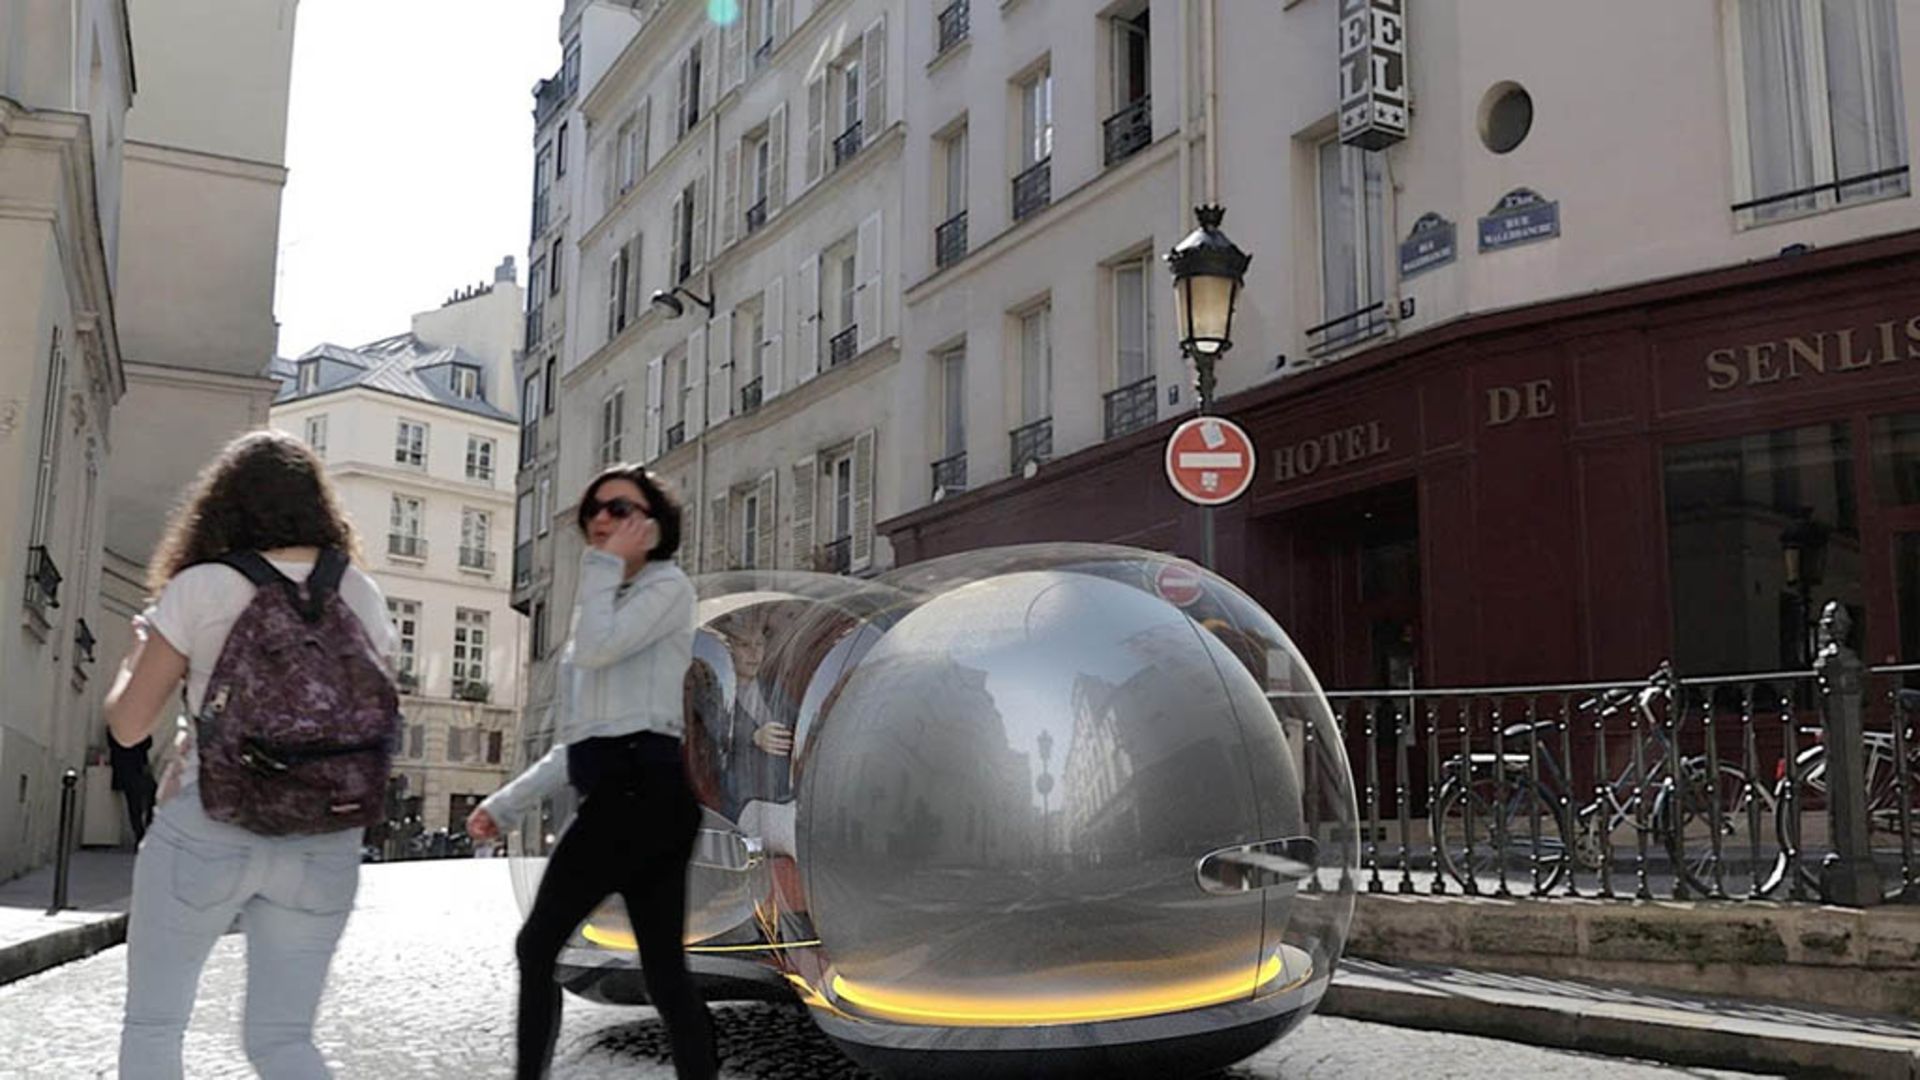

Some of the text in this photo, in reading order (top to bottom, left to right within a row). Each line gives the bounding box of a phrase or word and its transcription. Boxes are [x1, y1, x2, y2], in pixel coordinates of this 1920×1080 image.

[1340, 0, 1368, 106] EL
[1371, 0, 1403, 101] EL
[1272, 420, 1391, 482] HOTEL
[1485, 378, 1556, 427] DE
